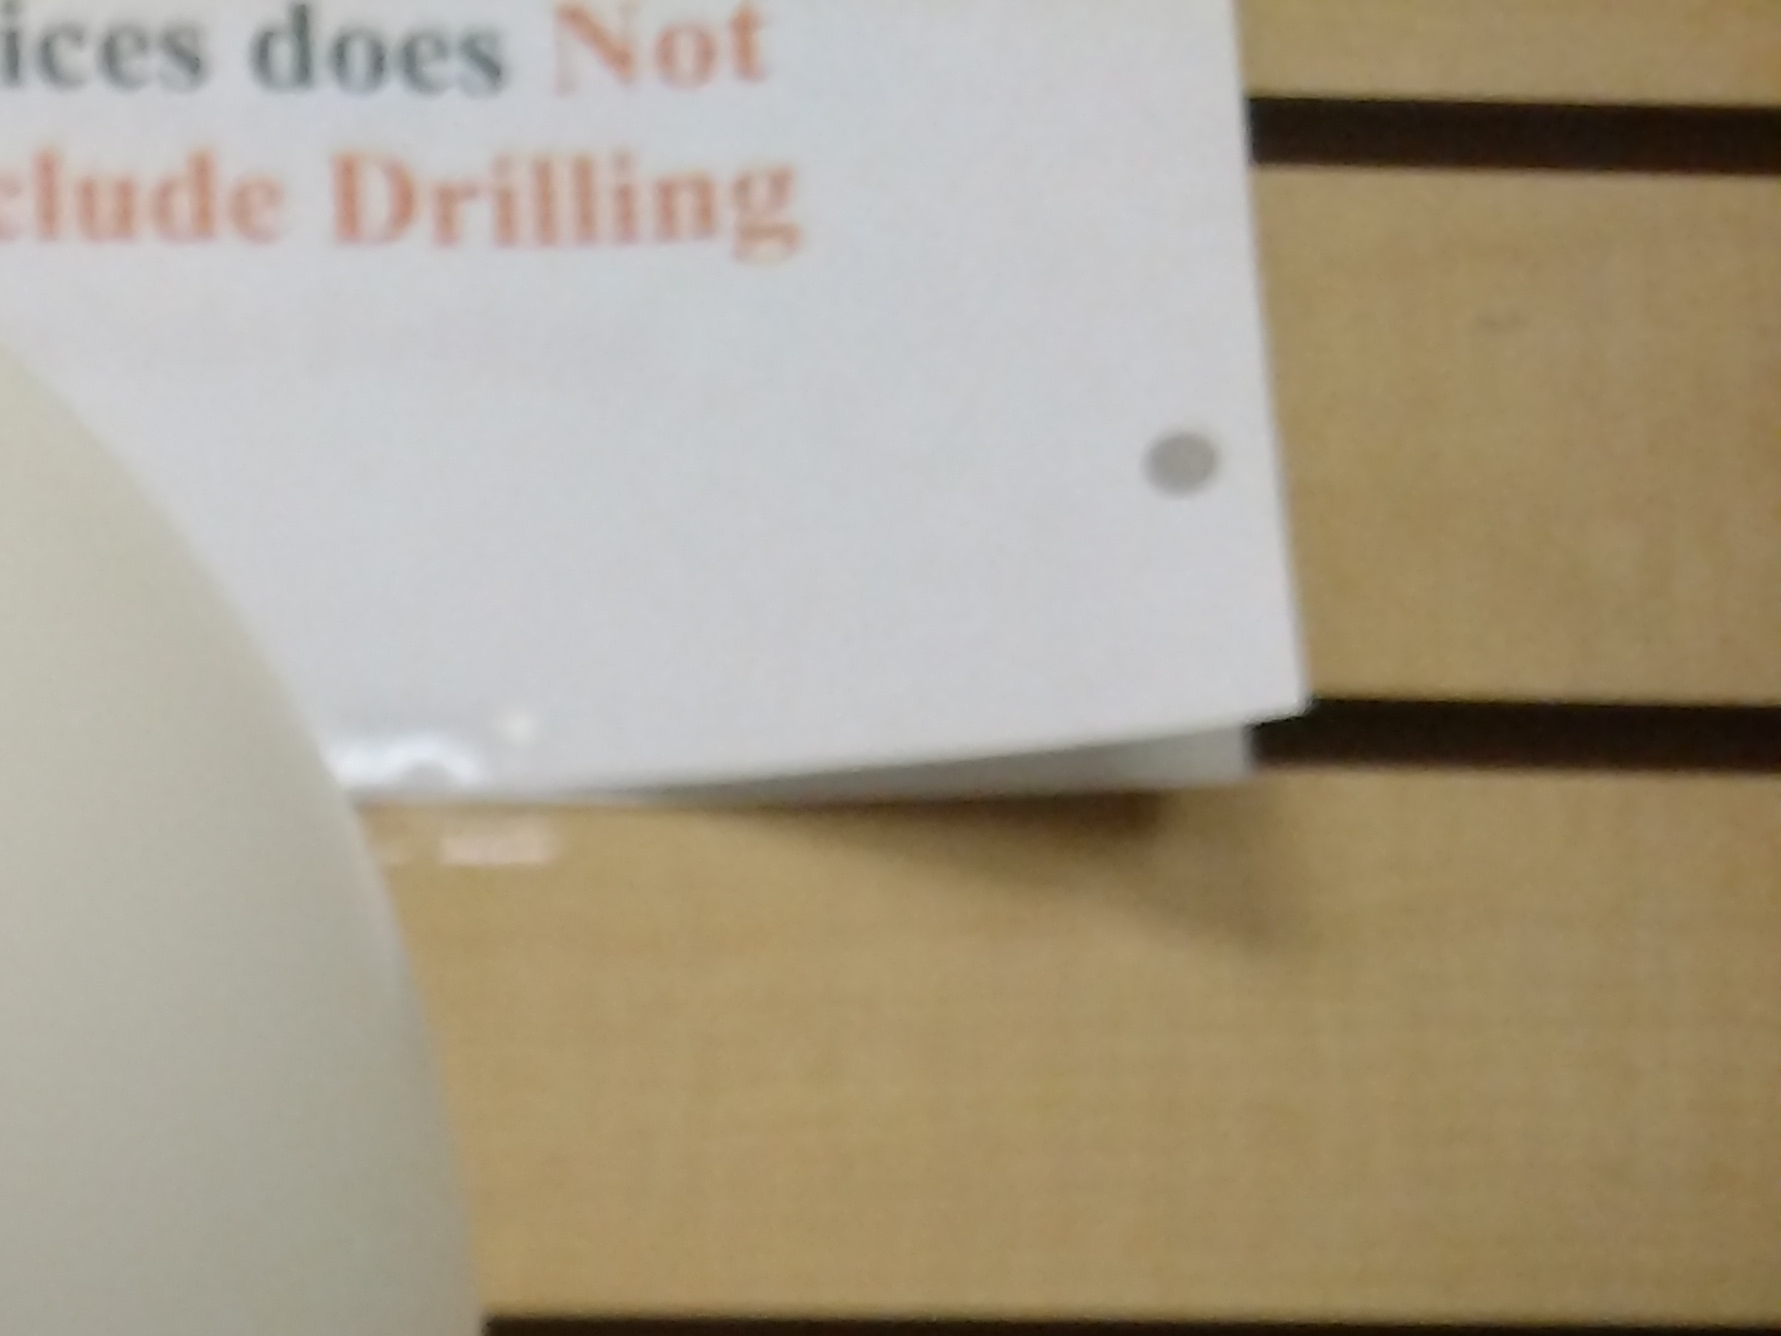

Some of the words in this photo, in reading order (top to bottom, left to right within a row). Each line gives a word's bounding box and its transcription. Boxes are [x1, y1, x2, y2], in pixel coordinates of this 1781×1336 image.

[252, 2, 510, 95] does
[556, 0, 767, 92] Not
[331, 150, 803, 262] Drilling
